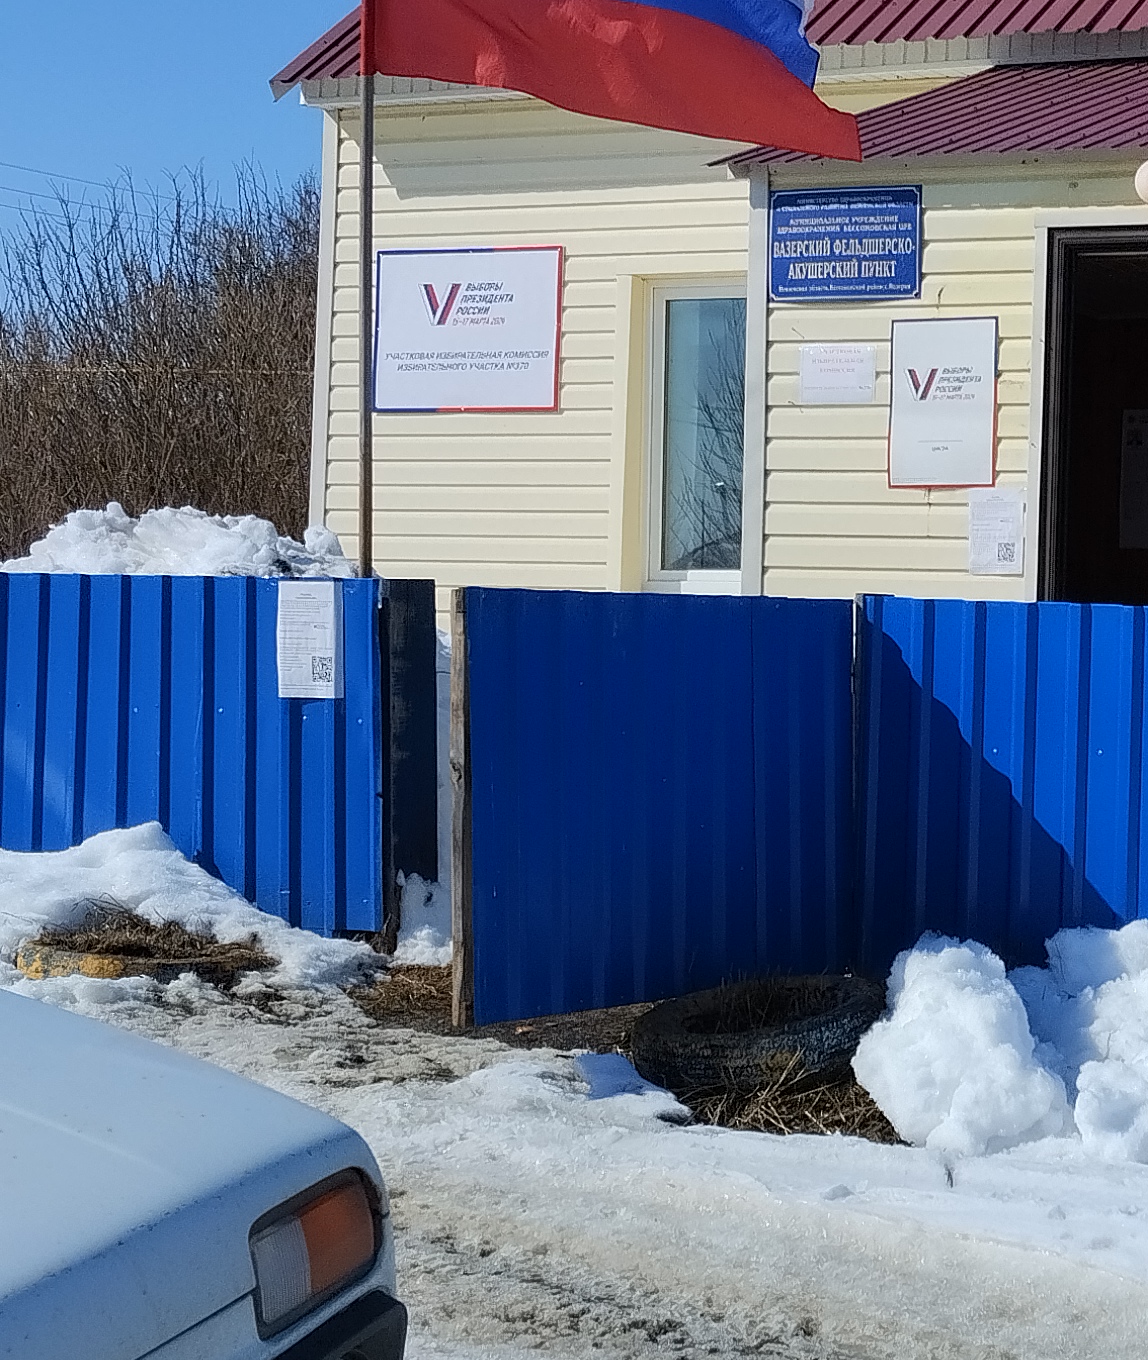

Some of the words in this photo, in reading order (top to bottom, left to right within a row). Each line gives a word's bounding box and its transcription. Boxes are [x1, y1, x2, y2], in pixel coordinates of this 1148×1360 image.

[773, 237, 831, 258] ВАЗЕРСКИЙ
[833, 237, 915, 257] ФЕЛЬДШЕРСКО-
[788, 258, 858, 279] АКУШЕРСКИЙ
[861, 260, 897, 278] ПУНКТ
[465, 282, 503, 291] ВЫБОРЫ
[461, 293, 514, 304] ПРЕЗИДЕНТА
[455, 306, 490, 315] РОССИИ
[384, 351, 435, 360] УЧАСТКОВАЯ
